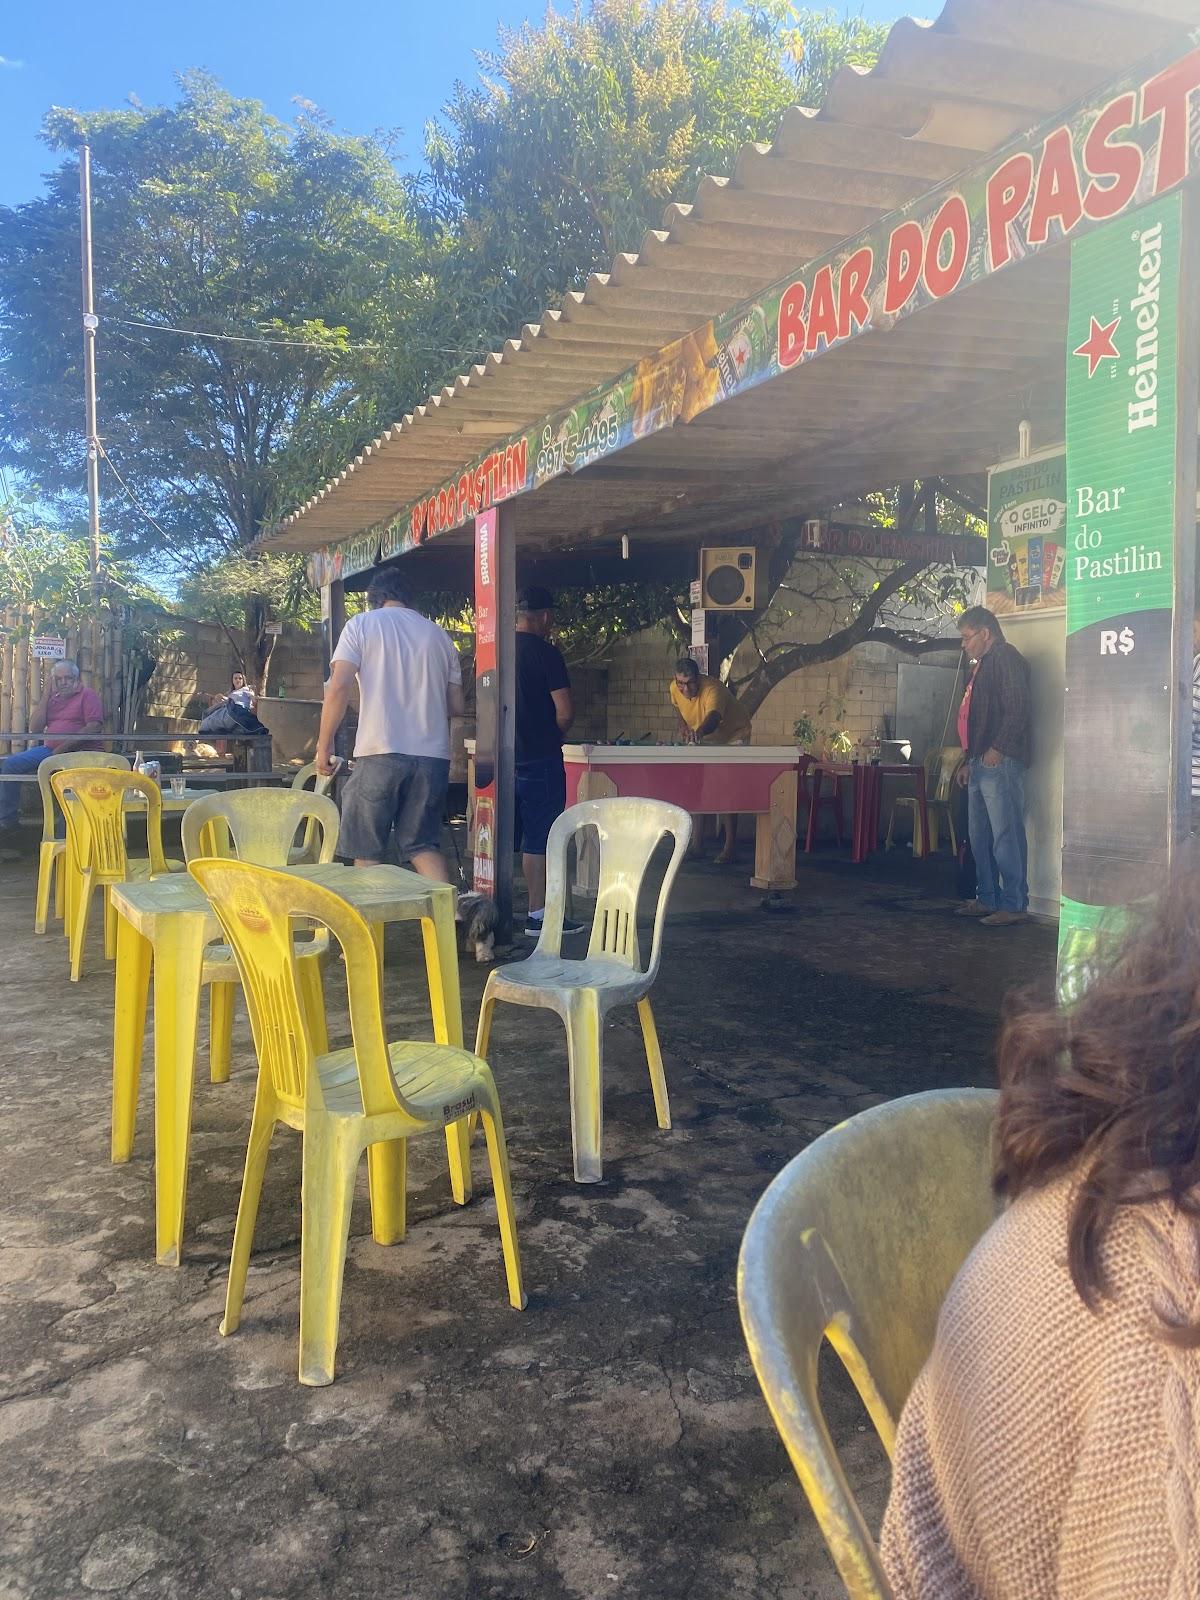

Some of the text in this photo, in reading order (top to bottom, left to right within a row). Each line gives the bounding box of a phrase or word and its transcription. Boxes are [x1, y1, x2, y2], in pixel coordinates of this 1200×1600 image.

[778, 246, 874, 369] BAR
[883, 194, 971, 314] DO
[1128, 221, 1163, 434] Heineken
[438, 482, 456, 532] DO
[1008, 502, 1058, 524] O GELO
[1075, 486, 1126, 518] Bar
[1074, 524, 1103, 551] do
[481, 523, 490, 585] BRAHMA
[1074, 545, 1163, 581] Pastilin
[478, 605, 489, 619] Bar
[1100, 626, 1136, 656] R$
[443, 1091, 476, 1116] Brasul
